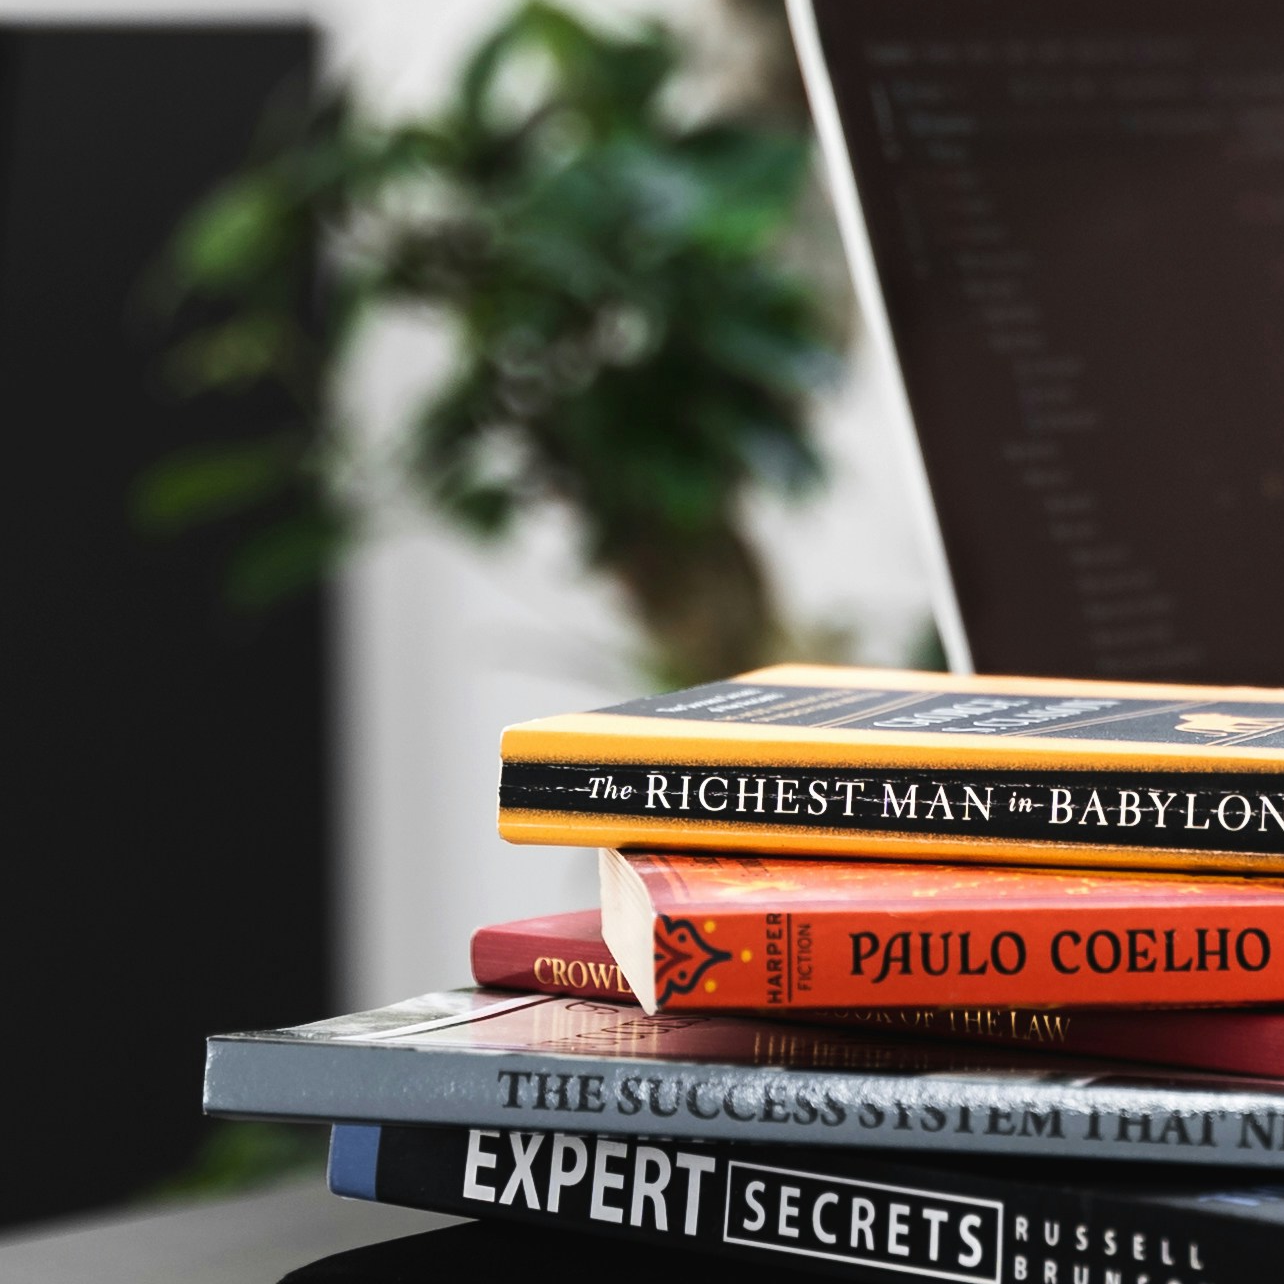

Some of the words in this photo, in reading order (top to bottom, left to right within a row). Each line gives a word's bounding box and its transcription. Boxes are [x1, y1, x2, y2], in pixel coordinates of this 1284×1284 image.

[588, 776, 633, 802] The
[644, 772, 865, 818] RICHEST
[881, 781, 995, 822] MAN
[1009, 791, 1036, 814] in
[765, 912, 783, 1005] HARPER
[796, 923, 813, 992] FICTION
[850, 930, 1027, 984] PAULO
[1052, 927, 1272, 976] COELHO
[1010, 1011, 1071, 1044] LAW
[498, 1070, 605, 1113] THE
[617, 1073, 846, 1128] SUCCESS
[1082, 1102, 1226, 1149] THAT
[462, 1128, 717, 1236] EXPERT
[742, 1179, 985, 1270] SECRETS
[1014, 1215, 1203, 1270] RUSSELL
